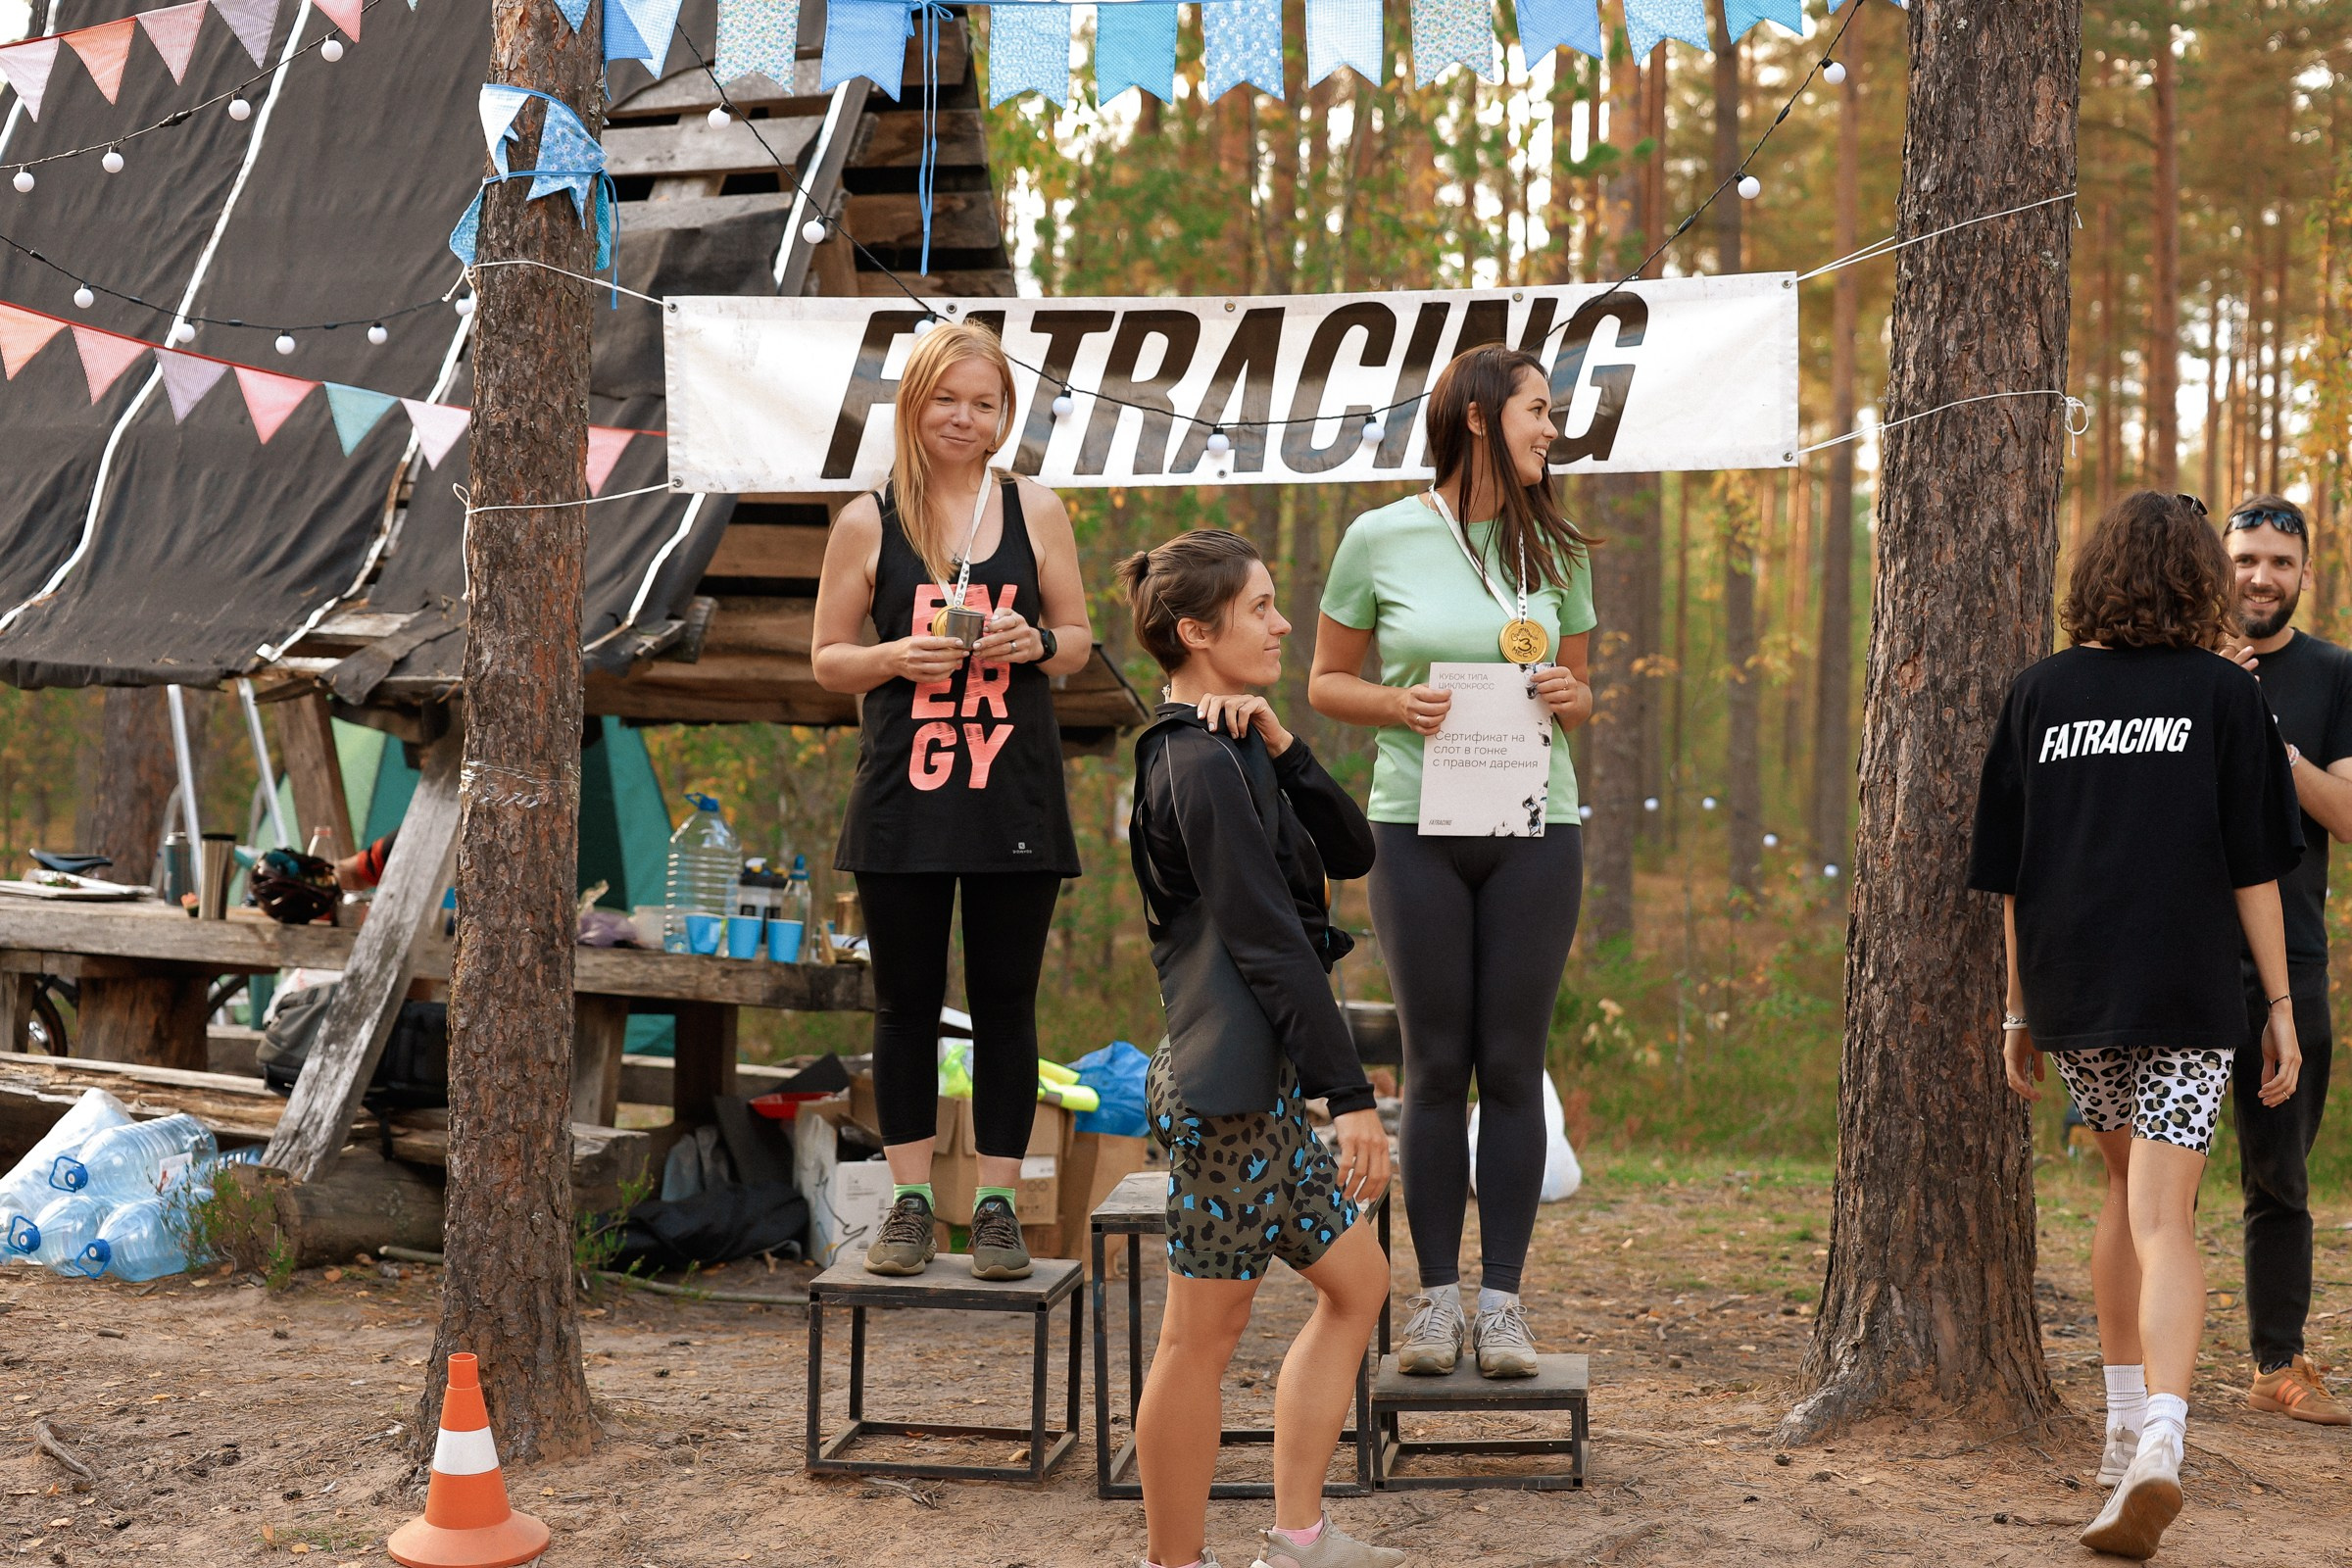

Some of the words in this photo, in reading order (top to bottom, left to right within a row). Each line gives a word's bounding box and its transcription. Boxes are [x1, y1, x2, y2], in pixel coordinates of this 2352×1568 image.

[820, 290, 1648, 479] FTRACIG
[1518, 637, 1533, 652] 3
[1435, 730, 1508, 745] Сертификат
[1511, 734, 1526, 743] на
[2038, 716, 2192, 763] FATRACING
[908, 721, 1014, 791] GY
[1434, 746, 1461, 755] слот
[1474, 747, 1507, 756] гонке
[1433, 759, 1441, 767] с
[1443, 759, 1487, 770] правом
[1490, 760, 1539, 771] дарения
